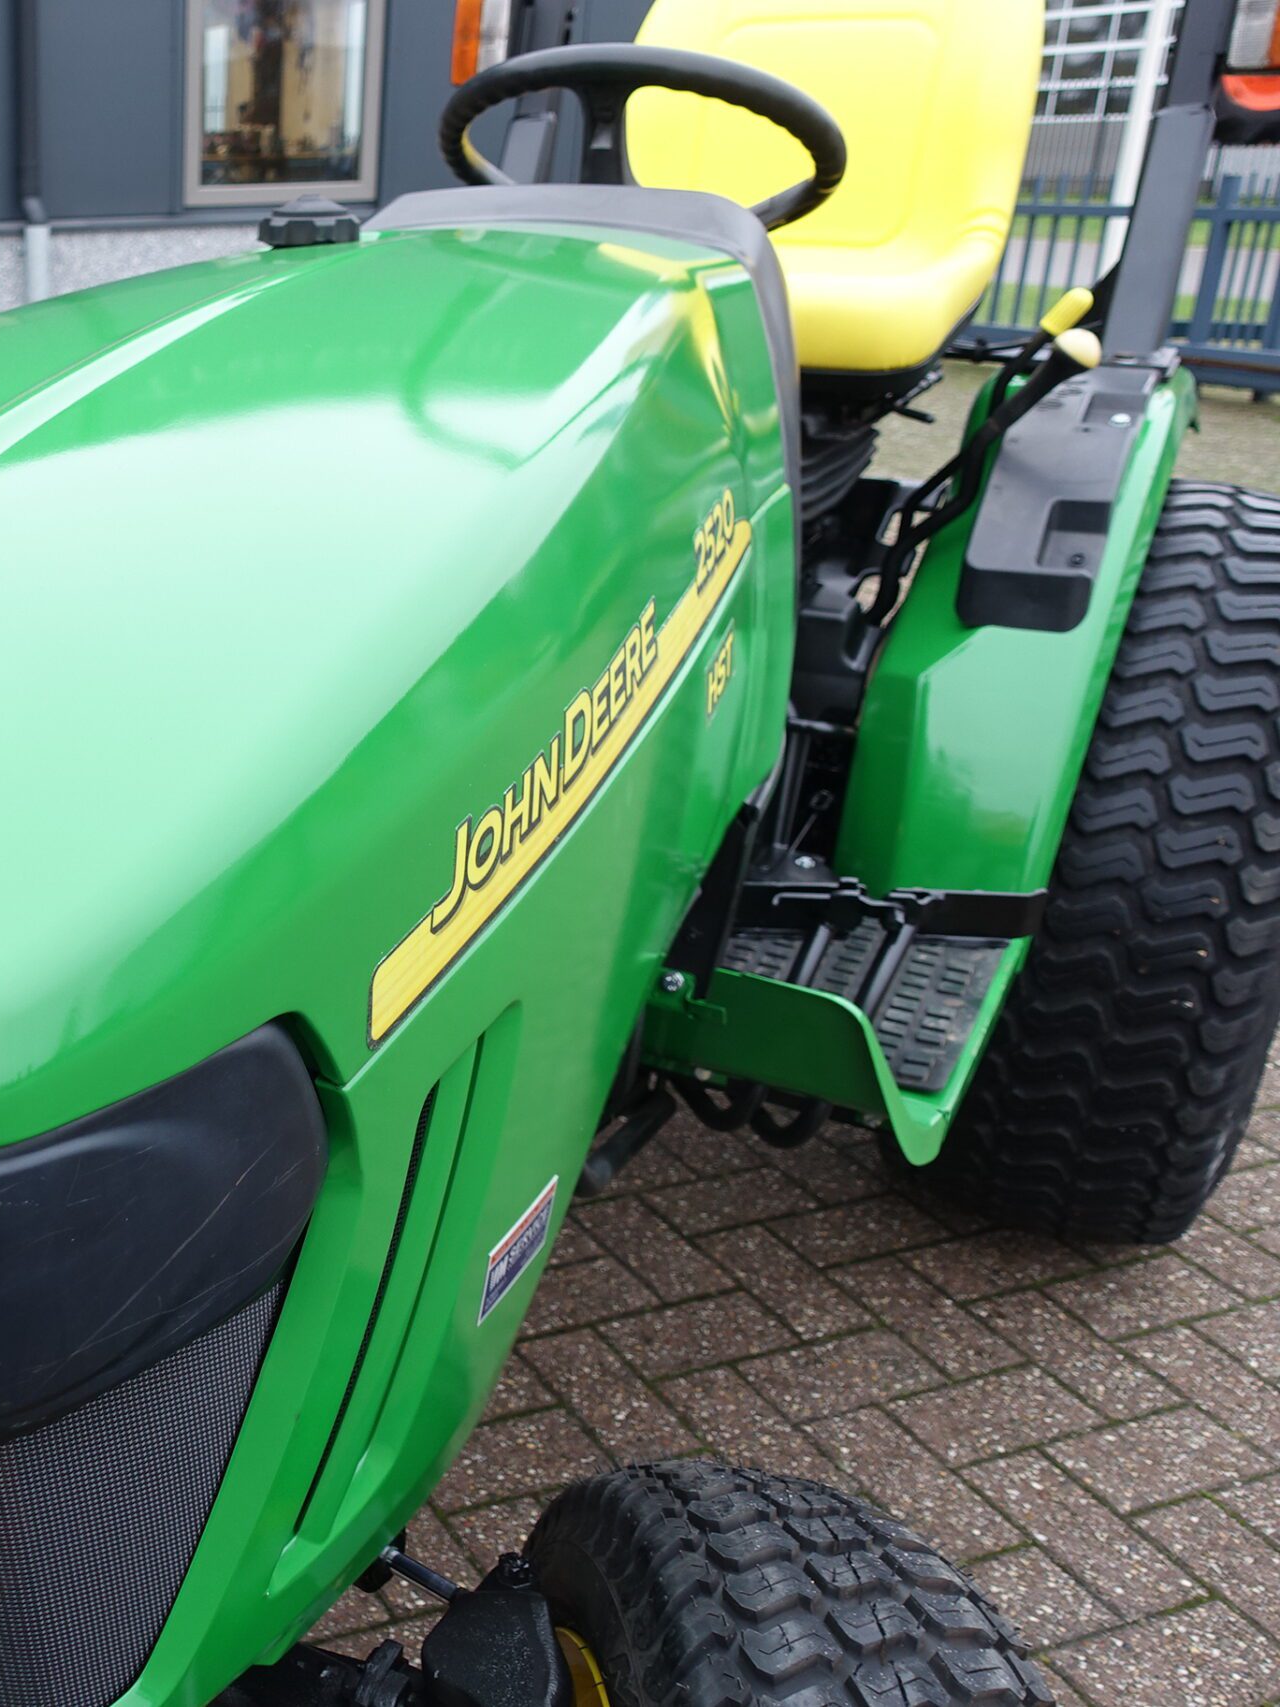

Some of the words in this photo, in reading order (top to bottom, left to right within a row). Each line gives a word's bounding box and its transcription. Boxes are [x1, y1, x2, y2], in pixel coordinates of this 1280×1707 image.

[694, 488, 734, 594] 2520
[706, 630, 734, 716] HST
[431, 733, 561, 932] JOHN
[564, 597, 657, 792] DEERE
